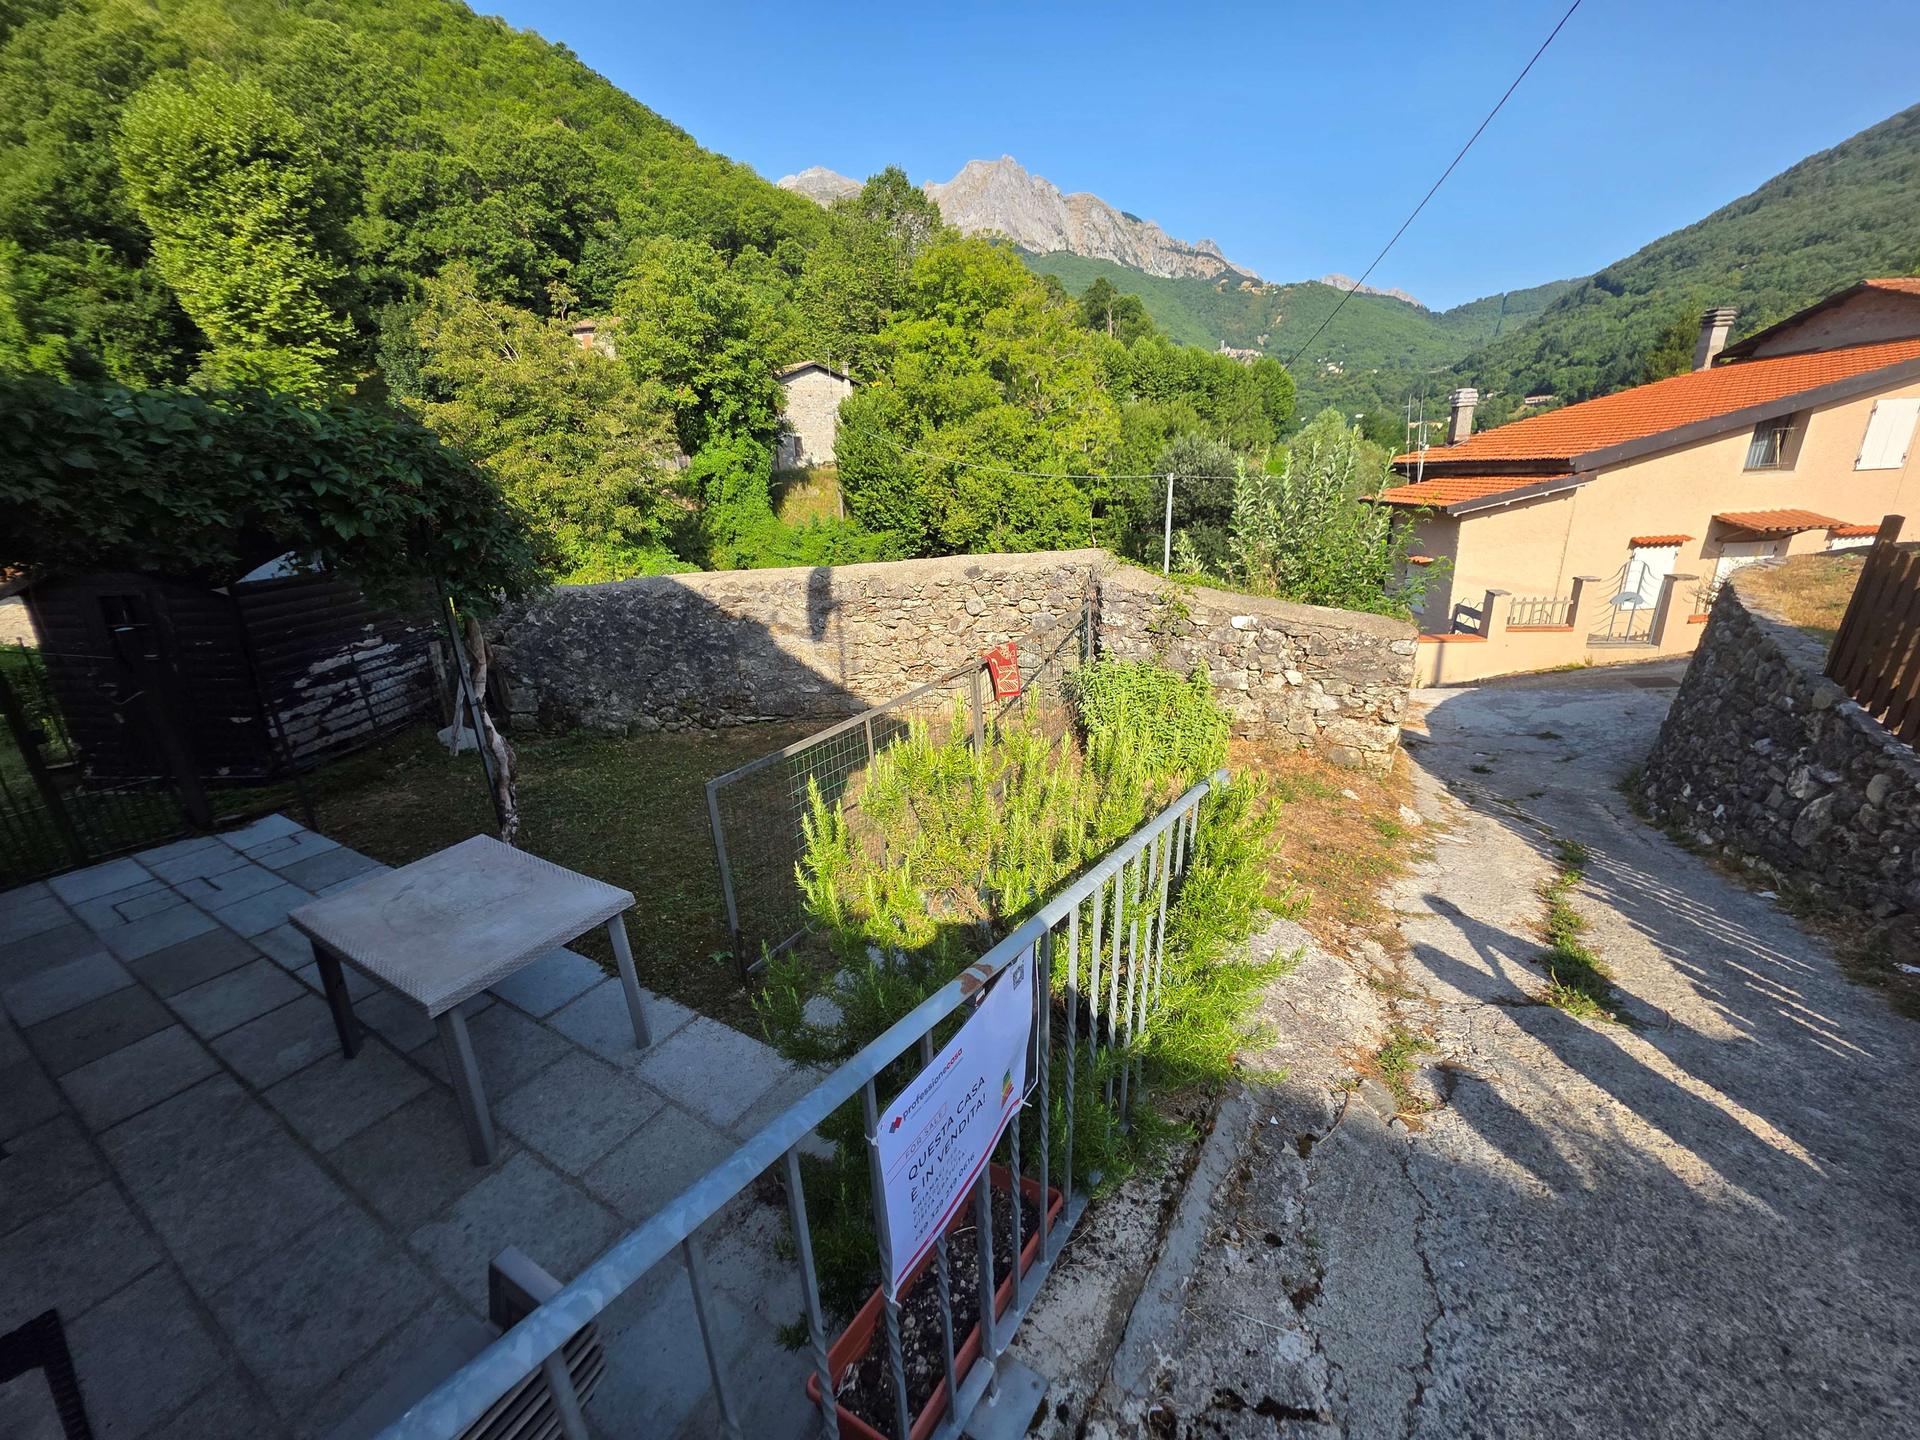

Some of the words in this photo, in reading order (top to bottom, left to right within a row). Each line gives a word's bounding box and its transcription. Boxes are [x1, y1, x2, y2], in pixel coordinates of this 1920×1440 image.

[903, 1048, 963, 1120] professionecasa
[905, 1137, 921, 1159] FOR
[908, 1116, 954, 1181] QUESTA
[957, 1077, 985, 1114] CASA
[911, 1186, 919, 1203] È
[922, 1165, 934, 1187] IN
[937, 1093, 986, 1163] VENDITA!
